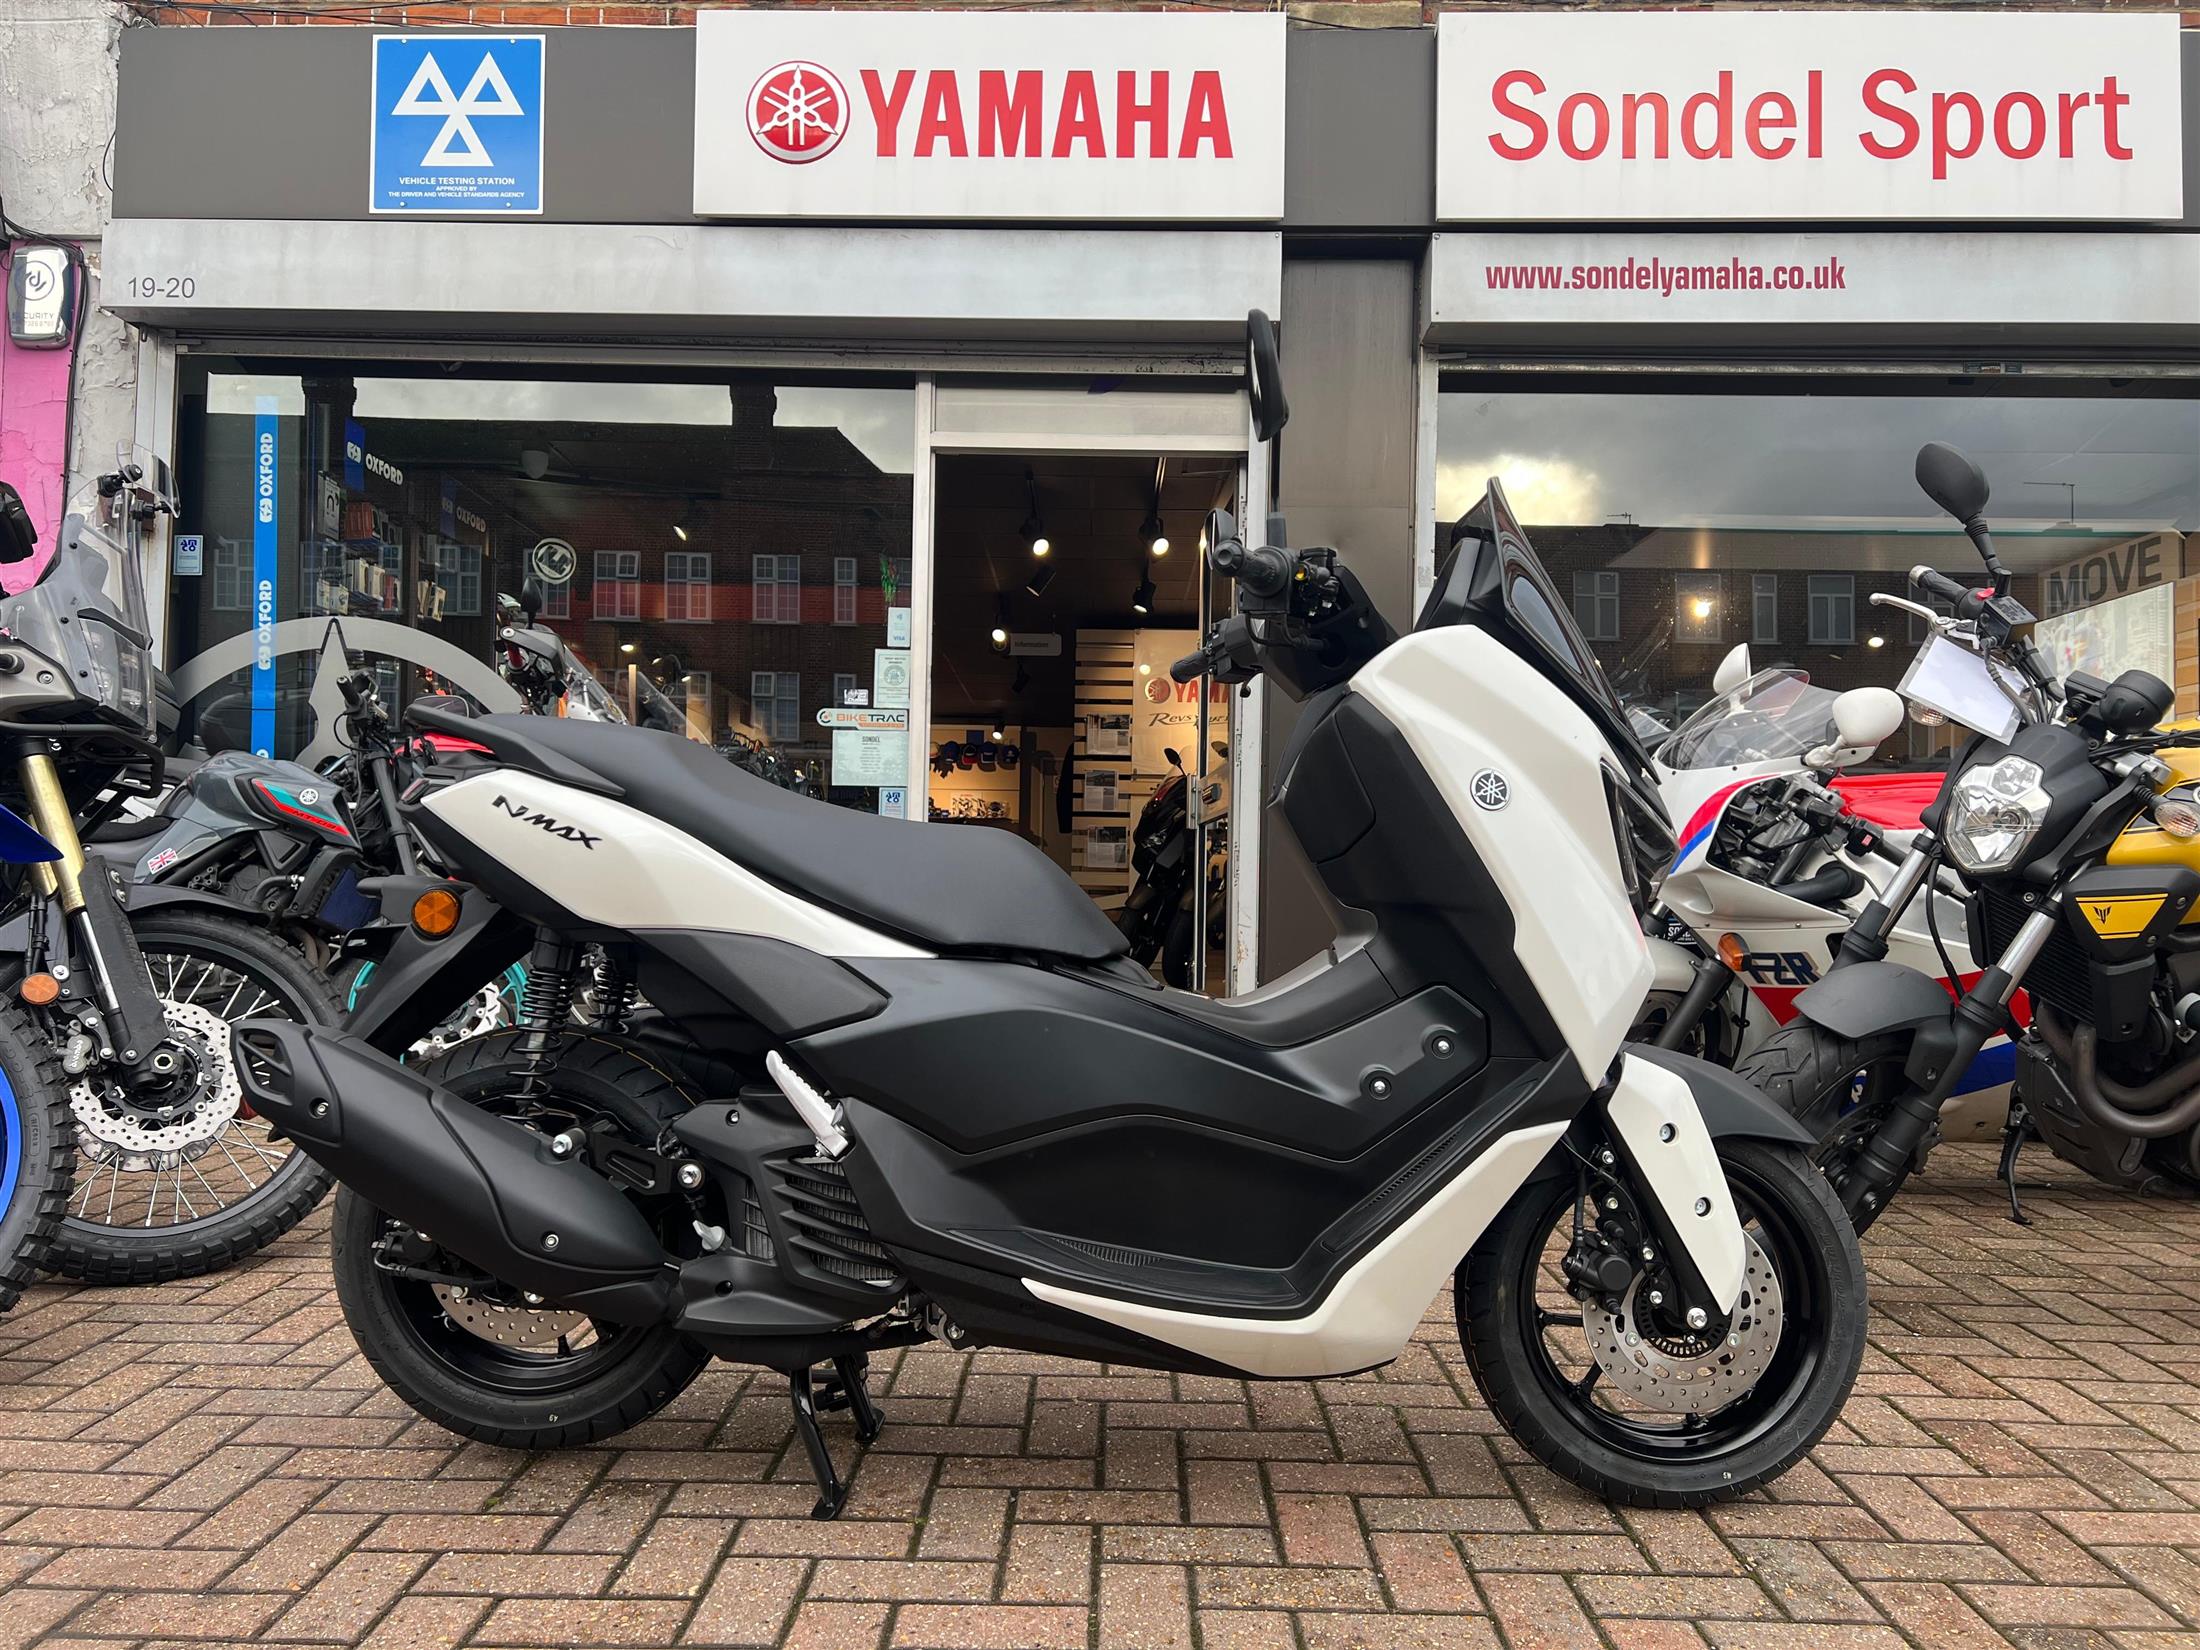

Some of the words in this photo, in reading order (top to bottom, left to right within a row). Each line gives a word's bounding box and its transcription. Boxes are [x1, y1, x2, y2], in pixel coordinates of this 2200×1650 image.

[860, 70, 1234, 159] YAMAHA
[1488, 70, 1824, 162] Sondel
[1859, 69, 2134, 181] Sport
[399, 176, 436, 185] VEHICLE
[438, 177, 476, 185] TESTING
[477, 177, 516, 185] STATION
[128, 277, 195, 299] 19-20
[1487, 256, 1846, 298] www.sondelyamaha.co.uk
[259, 432, 274, 497] OXFORD
[365, 453, 404, 486] OXFORD
[456, 505, 487, 533] OXFORD
[2049, 535, 2162, 614] MOVE
[258, 580, 272, 644] OXFORD
[836, 713, 905, 722] BIKETRAC
[1149, 712, 1192, 727] Revs
[491, 794, 603, 850] NMAX
